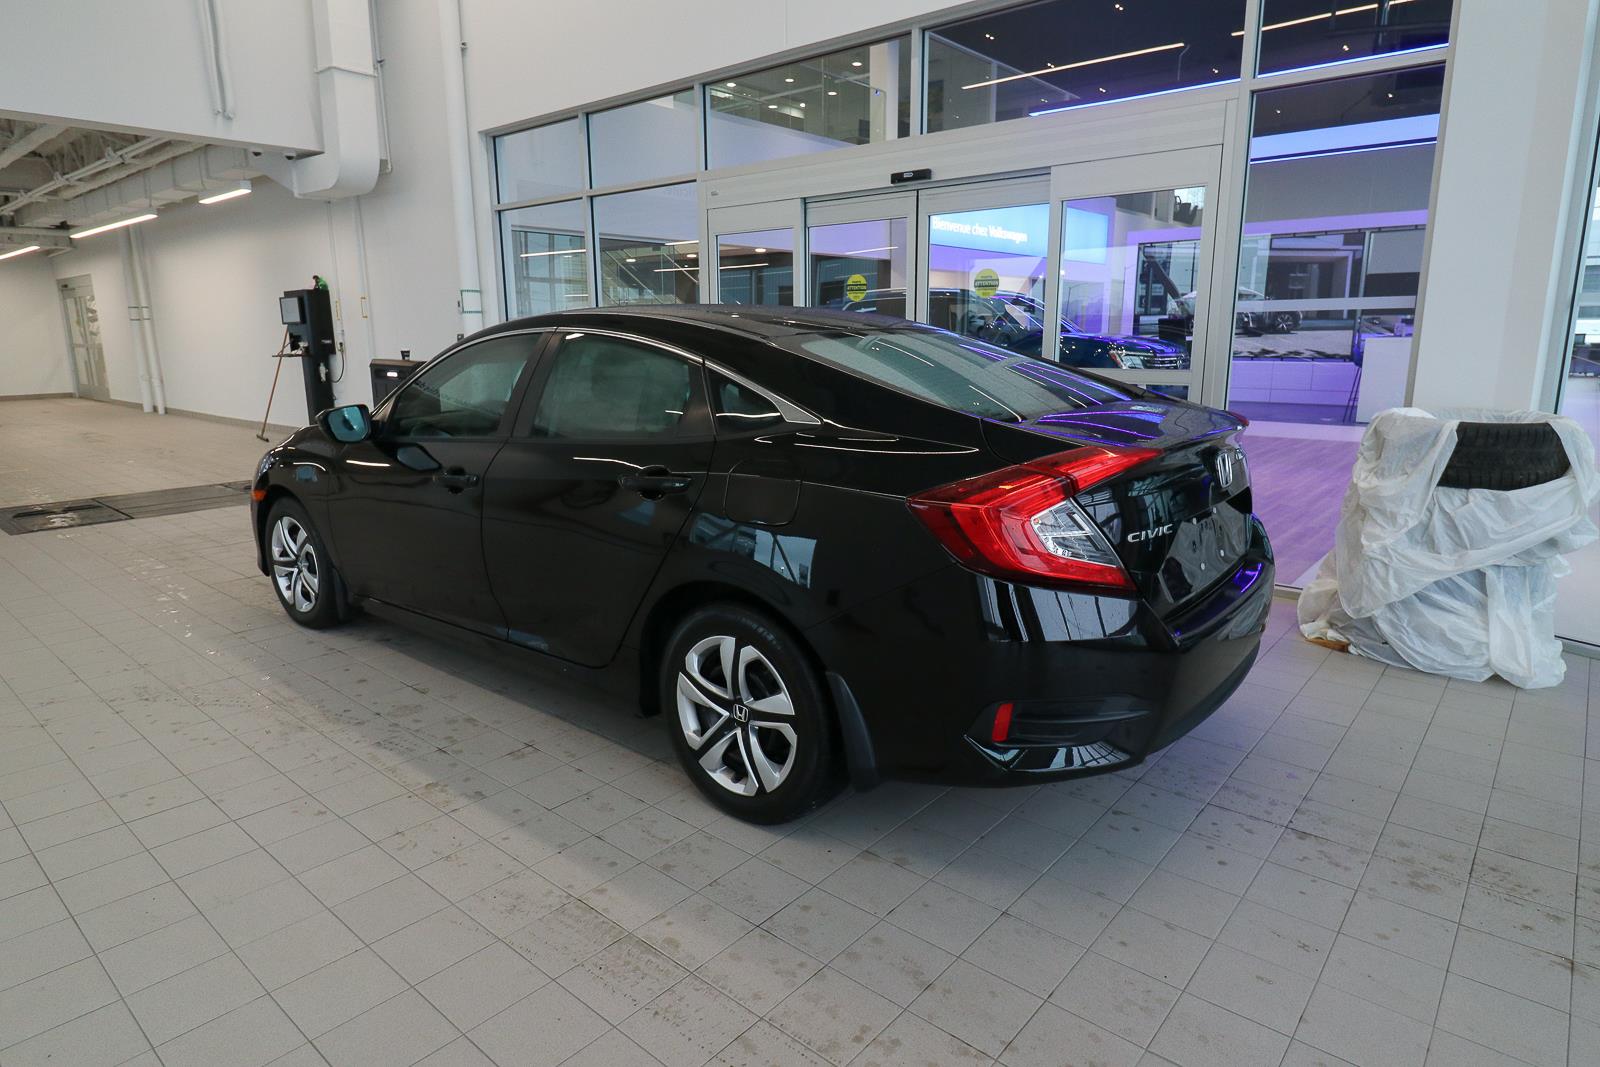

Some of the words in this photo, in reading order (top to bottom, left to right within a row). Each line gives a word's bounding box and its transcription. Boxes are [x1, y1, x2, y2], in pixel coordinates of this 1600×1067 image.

[933, 217, 971, 235] Bienvenue
[972, 223, 987, 237] chez
[989, 225, 1028, 244] Volkswagen
[1127, 523, 1173, 543] CIVIC
